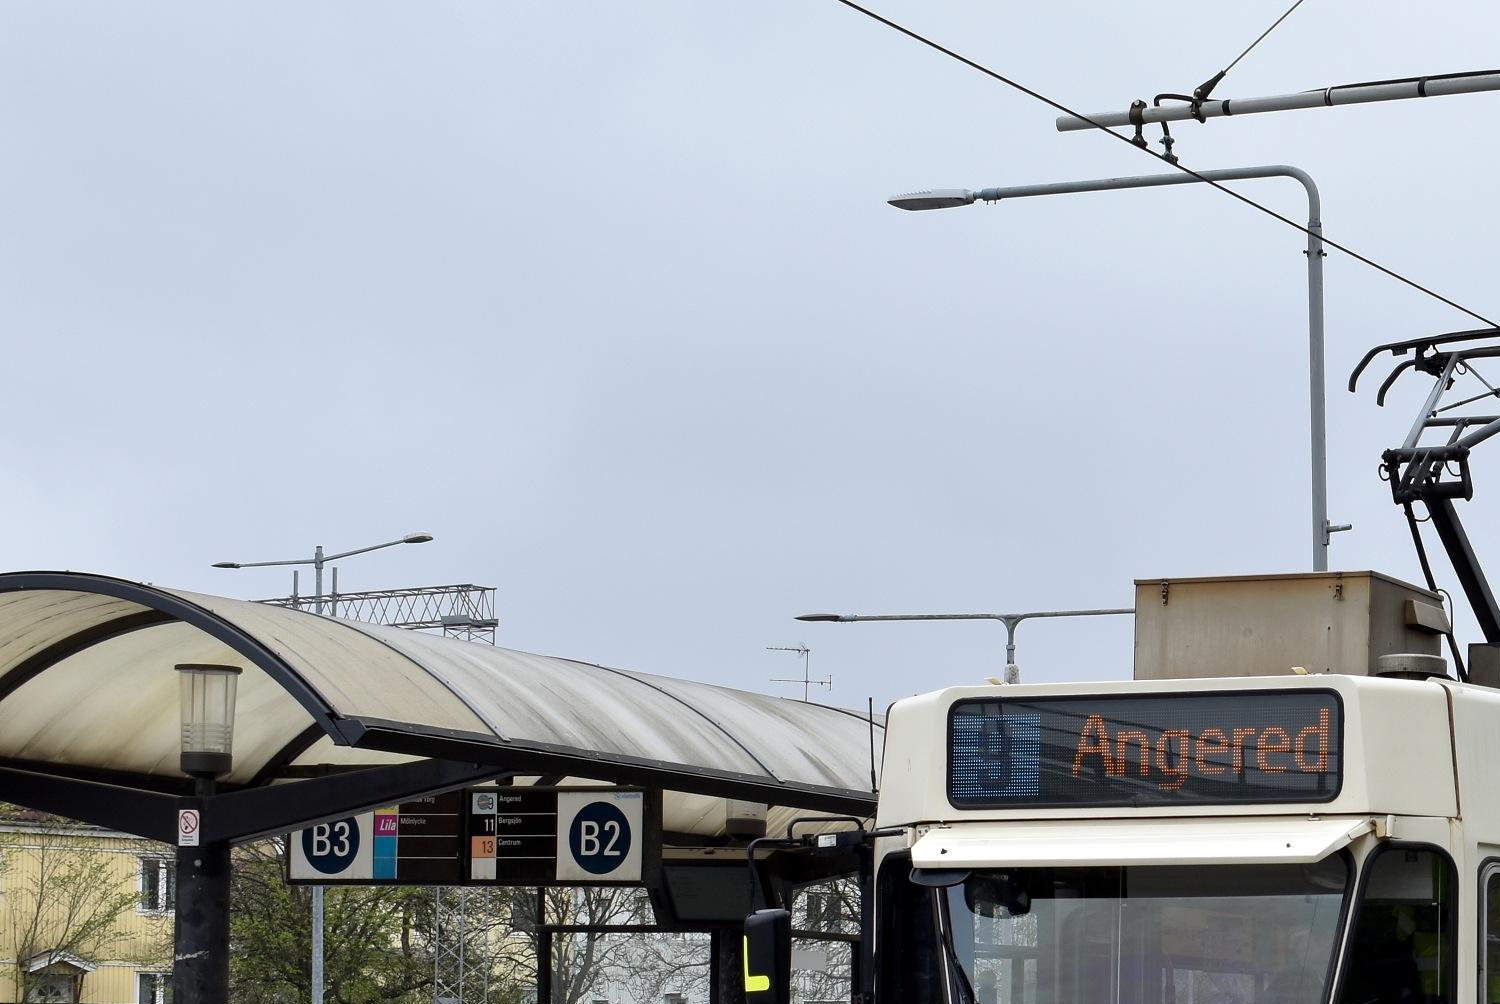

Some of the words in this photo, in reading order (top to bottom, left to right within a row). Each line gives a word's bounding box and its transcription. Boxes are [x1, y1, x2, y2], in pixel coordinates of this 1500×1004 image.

[977, 720, 1013, 789] 9
[1072, 705, 1329, 791] Angered
[499, 795, 522, 803] Angered
[380, 818, 397, 831] Lila
[484, 818, 494, 832] 11
[312, 821, 350, 857] B3
[482, 840, 494, 854] 13
[498, 838, 521, 846] Centrum
[580, 820, 621, 856] B2
